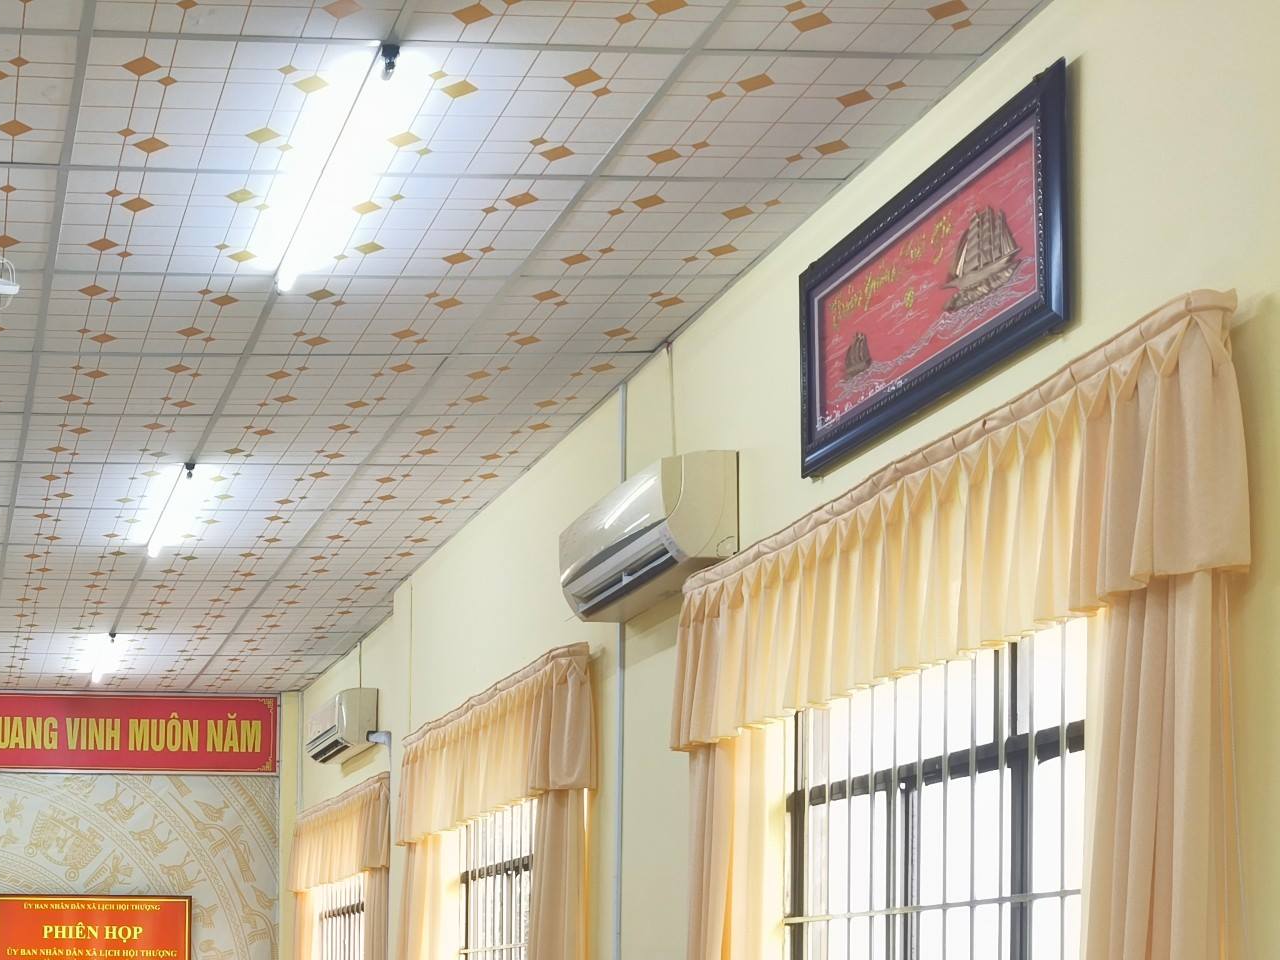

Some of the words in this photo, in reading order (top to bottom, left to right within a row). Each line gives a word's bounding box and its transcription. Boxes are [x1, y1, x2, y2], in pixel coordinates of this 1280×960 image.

[66, 717, 120, 750] VINH
[128, 712, 199, 752] MUÔN
[206, 713, 261, 752] NĂM
[42, 922, 99, 939] PHIÊN
[104, 926, 143, 943] HỌP
[40, 948, 64, 956] NHÂN
[66, 948, 83, 956] DÂN
[99, 950, 120, 958] LỊCH
[140, 950, 177, 958] THƯỢNG
